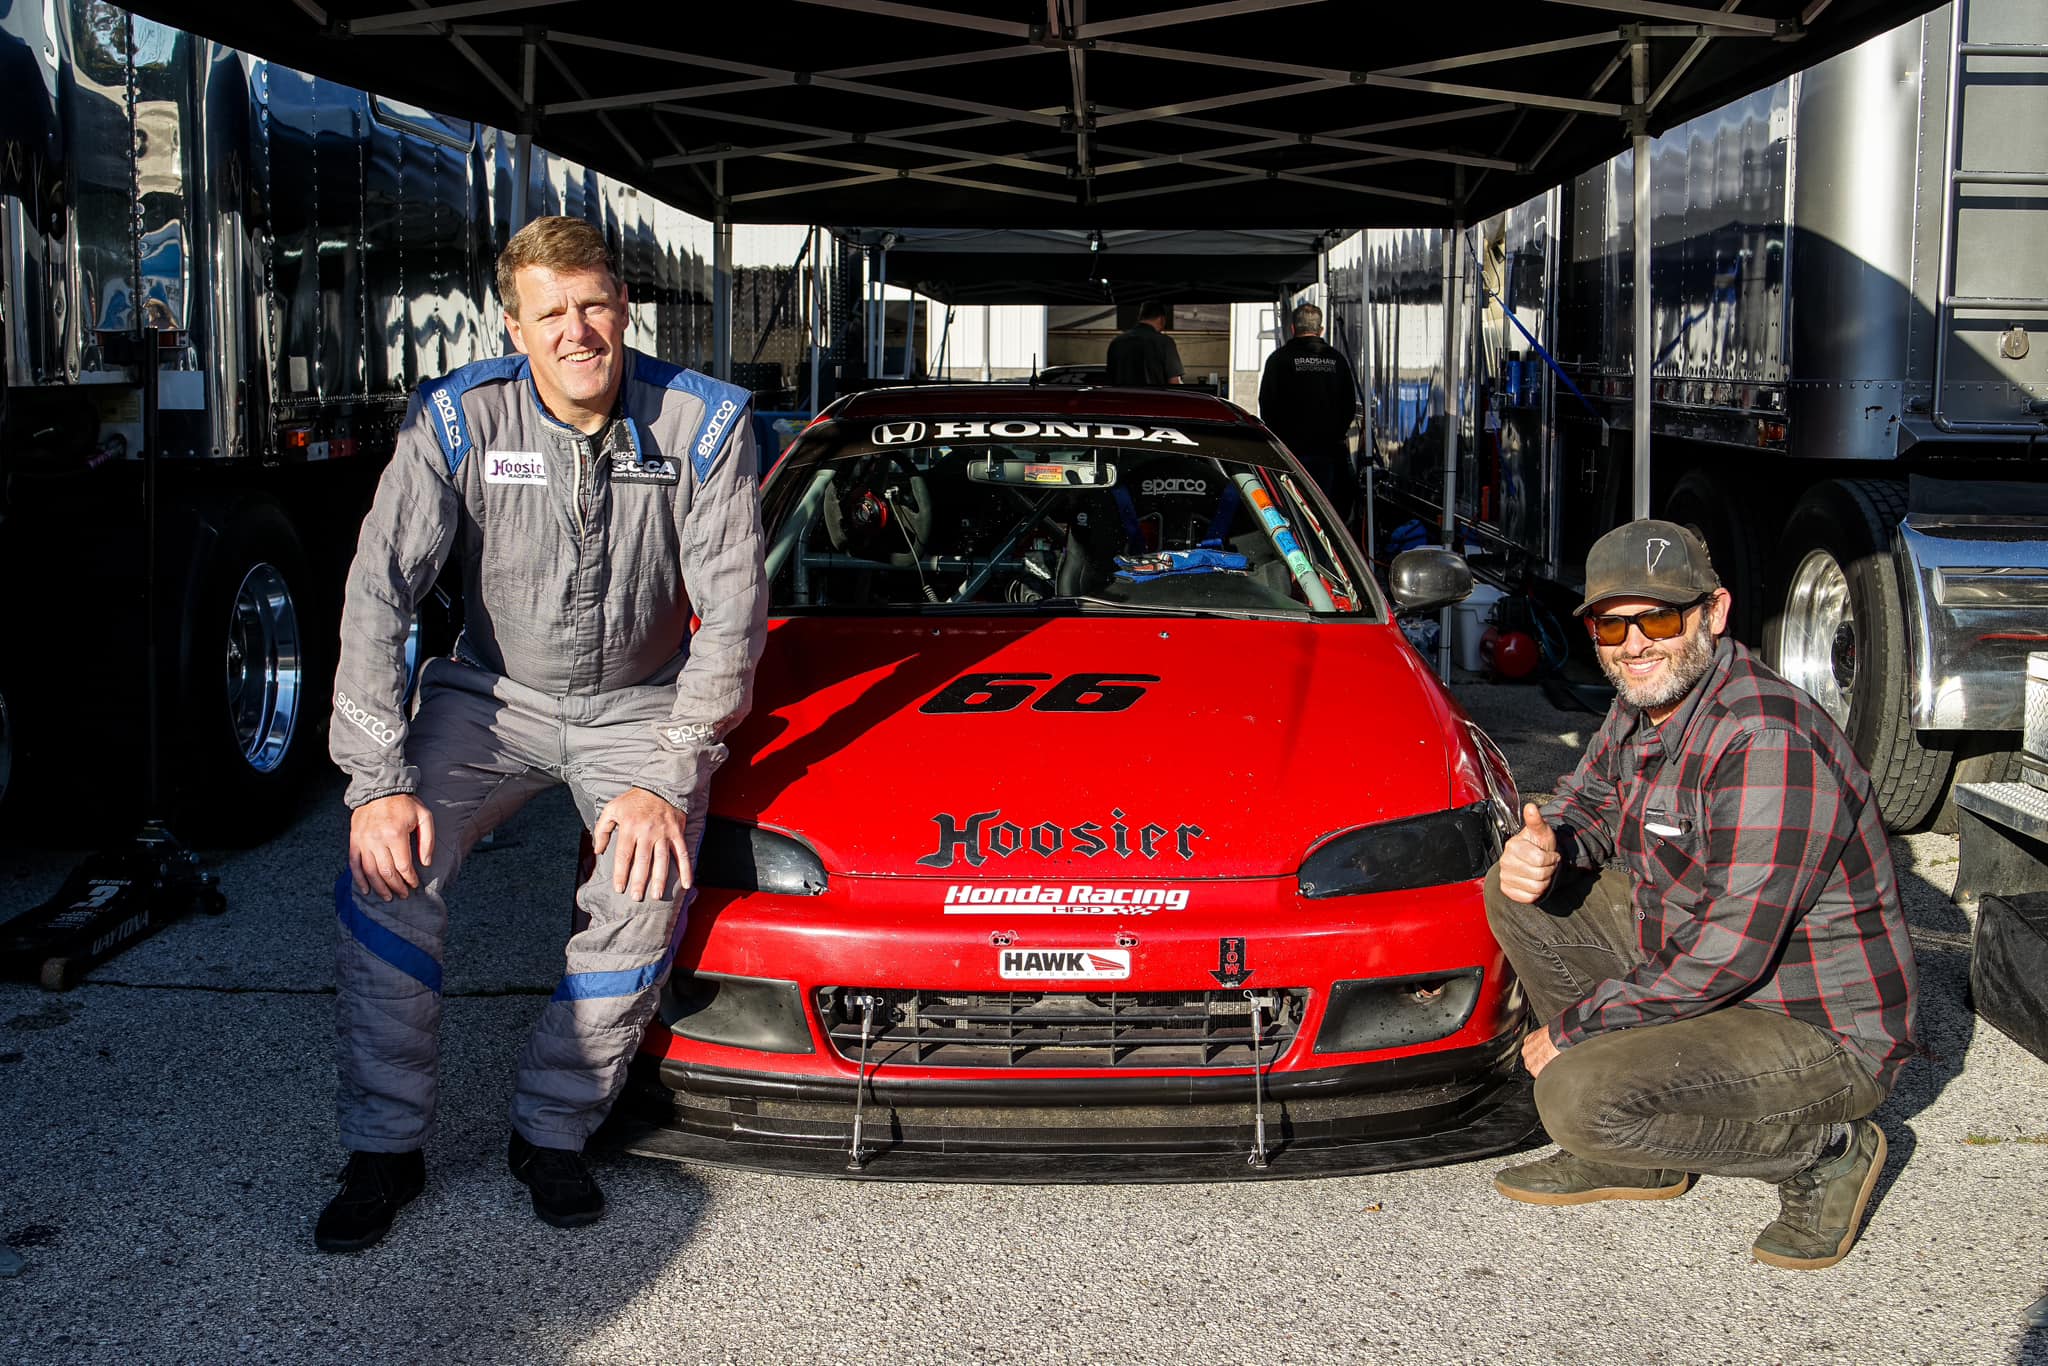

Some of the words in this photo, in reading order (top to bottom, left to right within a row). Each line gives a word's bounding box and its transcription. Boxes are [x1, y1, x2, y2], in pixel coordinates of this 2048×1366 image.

[432, 388, 462, 449] sparco
[698, 400, 737, 459] sparco
[934, 420, 1199, 446] HONDA
[612, 460, 677, 475] SCCA
[1141, 478, 1207, 496] sparco
[917, 672, 1161, 714] 66
[335, 692, 395, 747] sparco
[915, 807, 1204, 868] Hoosier
[944, 885, 1063, 904] Honda
[1067, 885, 1190, 911] Racing
[1051, 905, 1105, 914] HPD
[91, 909, 149, 956] DAYTONA
[1004, 951, 1086, 972] HAWK
[1225, 939, 1239, 975] TOW
